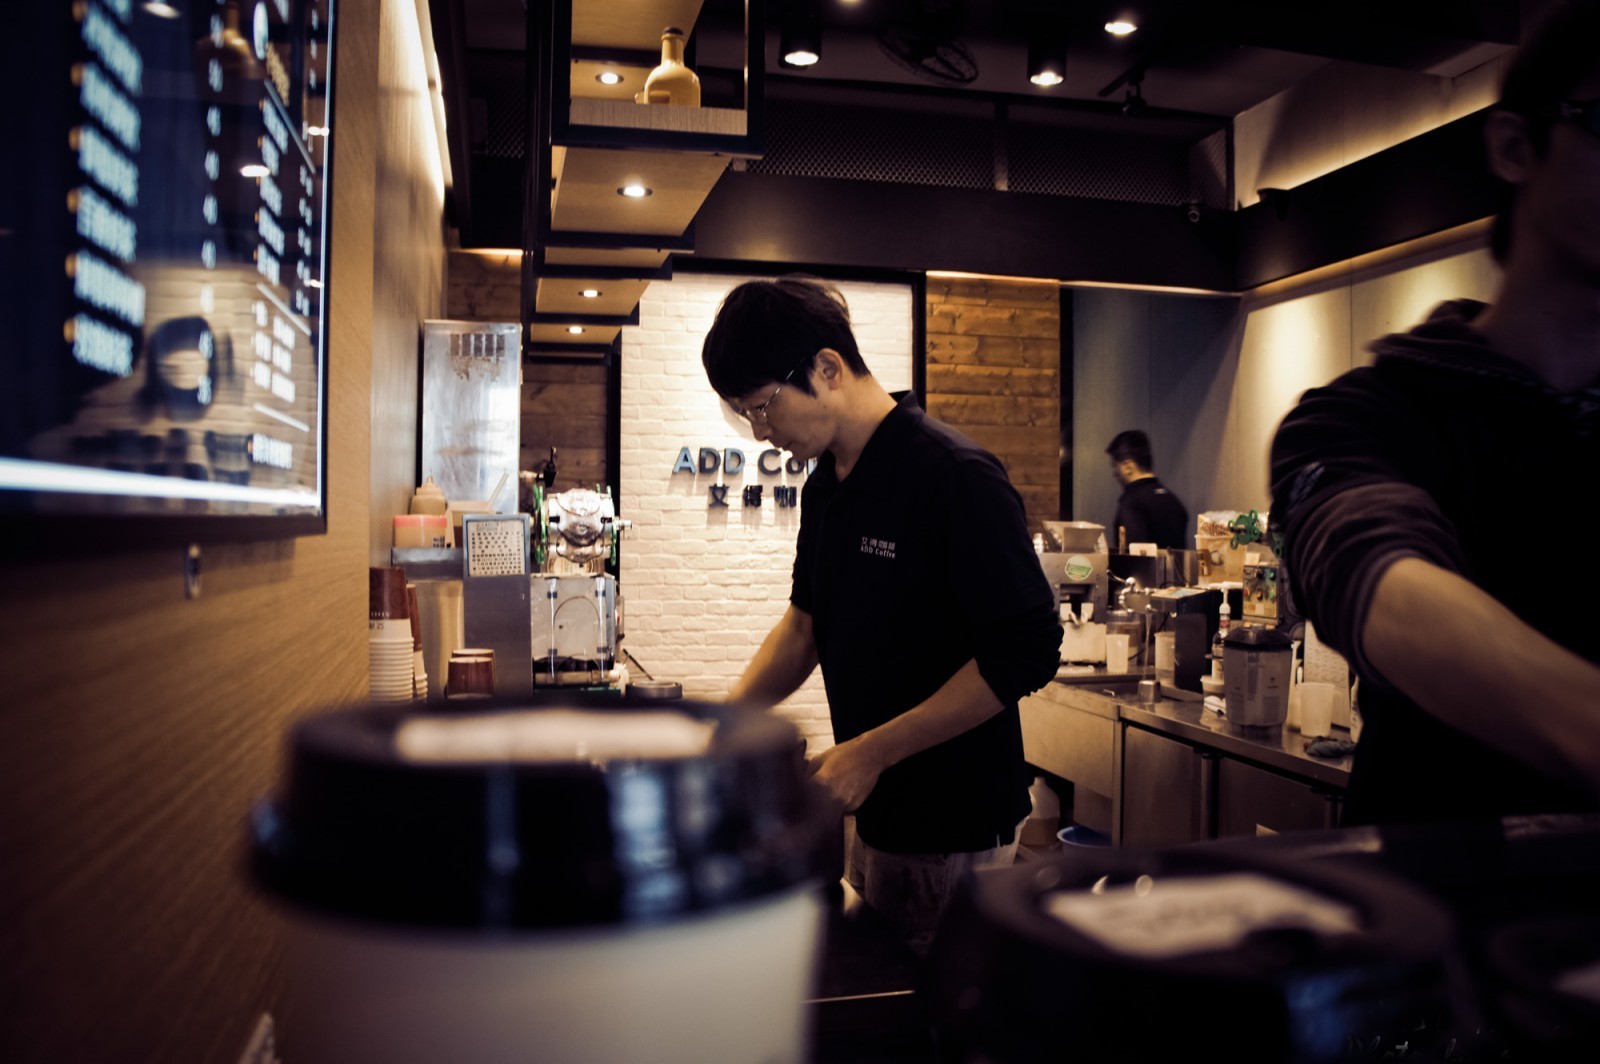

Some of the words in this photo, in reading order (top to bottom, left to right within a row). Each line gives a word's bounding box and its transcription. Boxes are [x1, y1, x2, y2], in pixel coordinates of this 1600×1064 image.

[672, 446, 746, 475] ADD
[860, 545, 874, 554] ADD
[875, 548, 896, 559] Coffee
